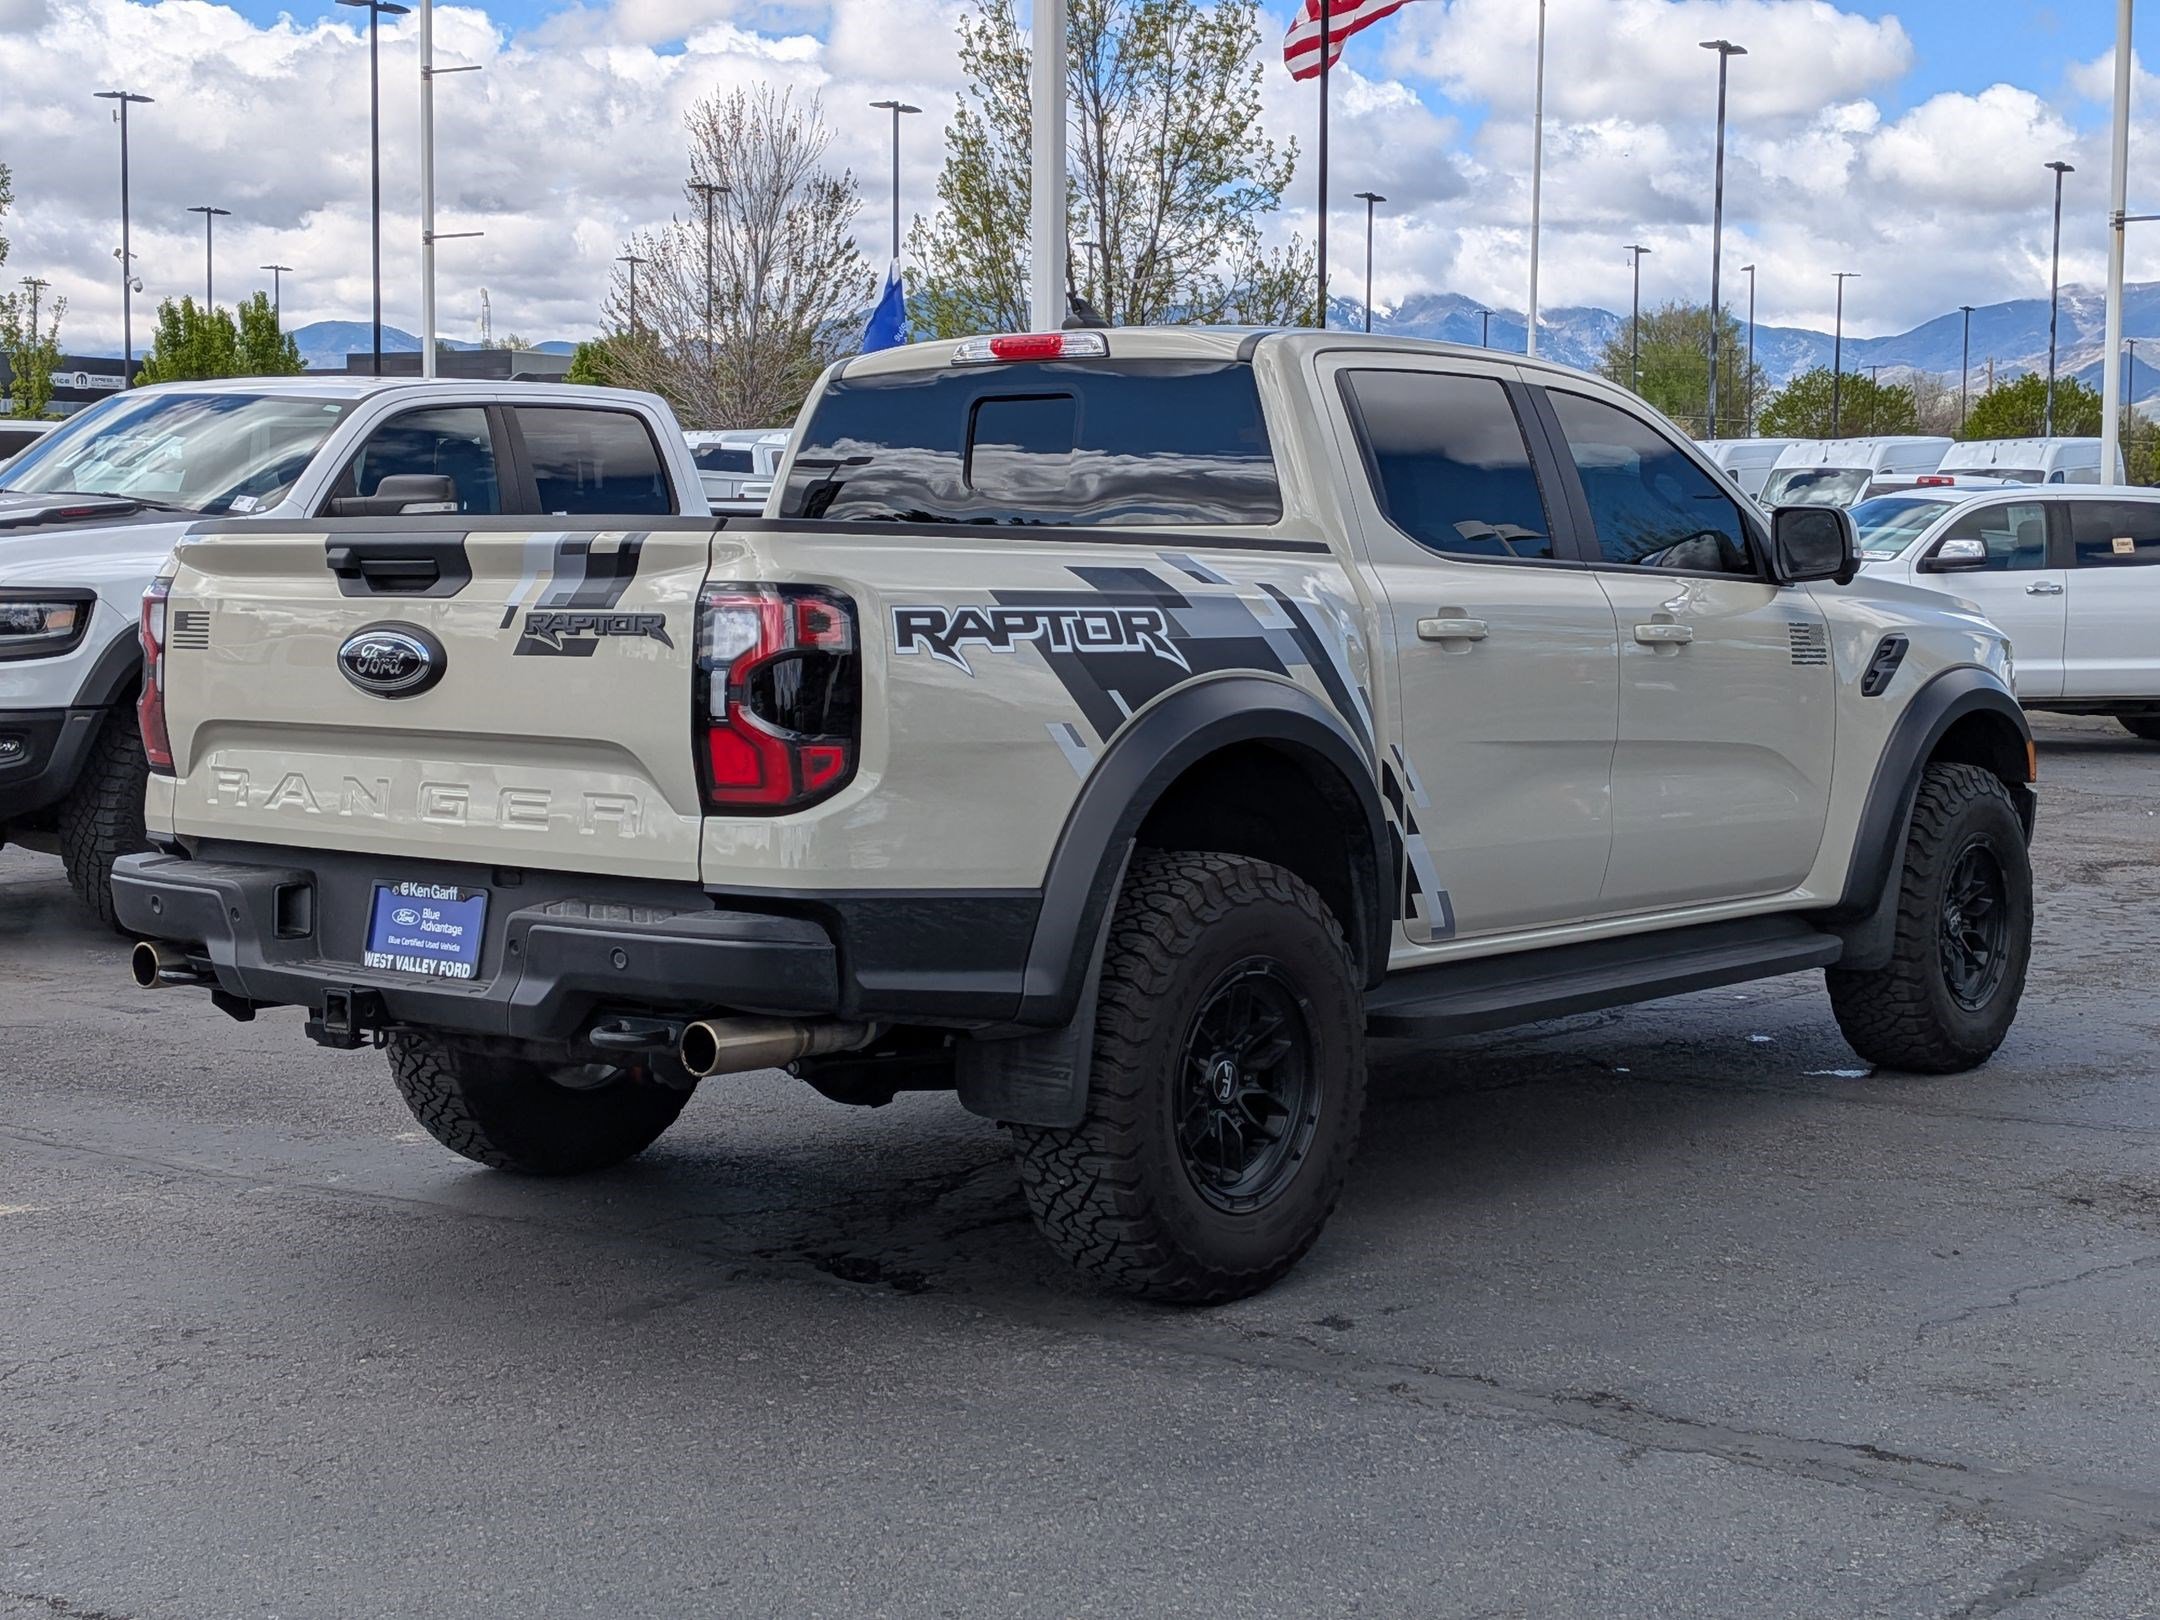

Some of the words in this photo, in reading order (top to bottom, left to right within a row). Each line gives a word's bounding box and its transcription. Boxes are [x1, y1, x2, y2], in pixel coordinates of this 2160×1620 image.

[525, 612, 674, 650] RAPTOR
[891, 606, 1192, 678] RAPTOR
[356, 643, 404, 674] Ford
[207, 766, 643, 839] RANGER
[410, 882, 430, 898] Ken
[431, 885, 458, 900] Garff
[396, 910, 415, 923] Ford
[422, 908, 440, 920] Blue
[420, 920, 463, 936] Advantage
[364, 952, 394, 969] WEST
[396, 955, 437, 974] VALLEY
[438, 961, 470, 978] FORD
